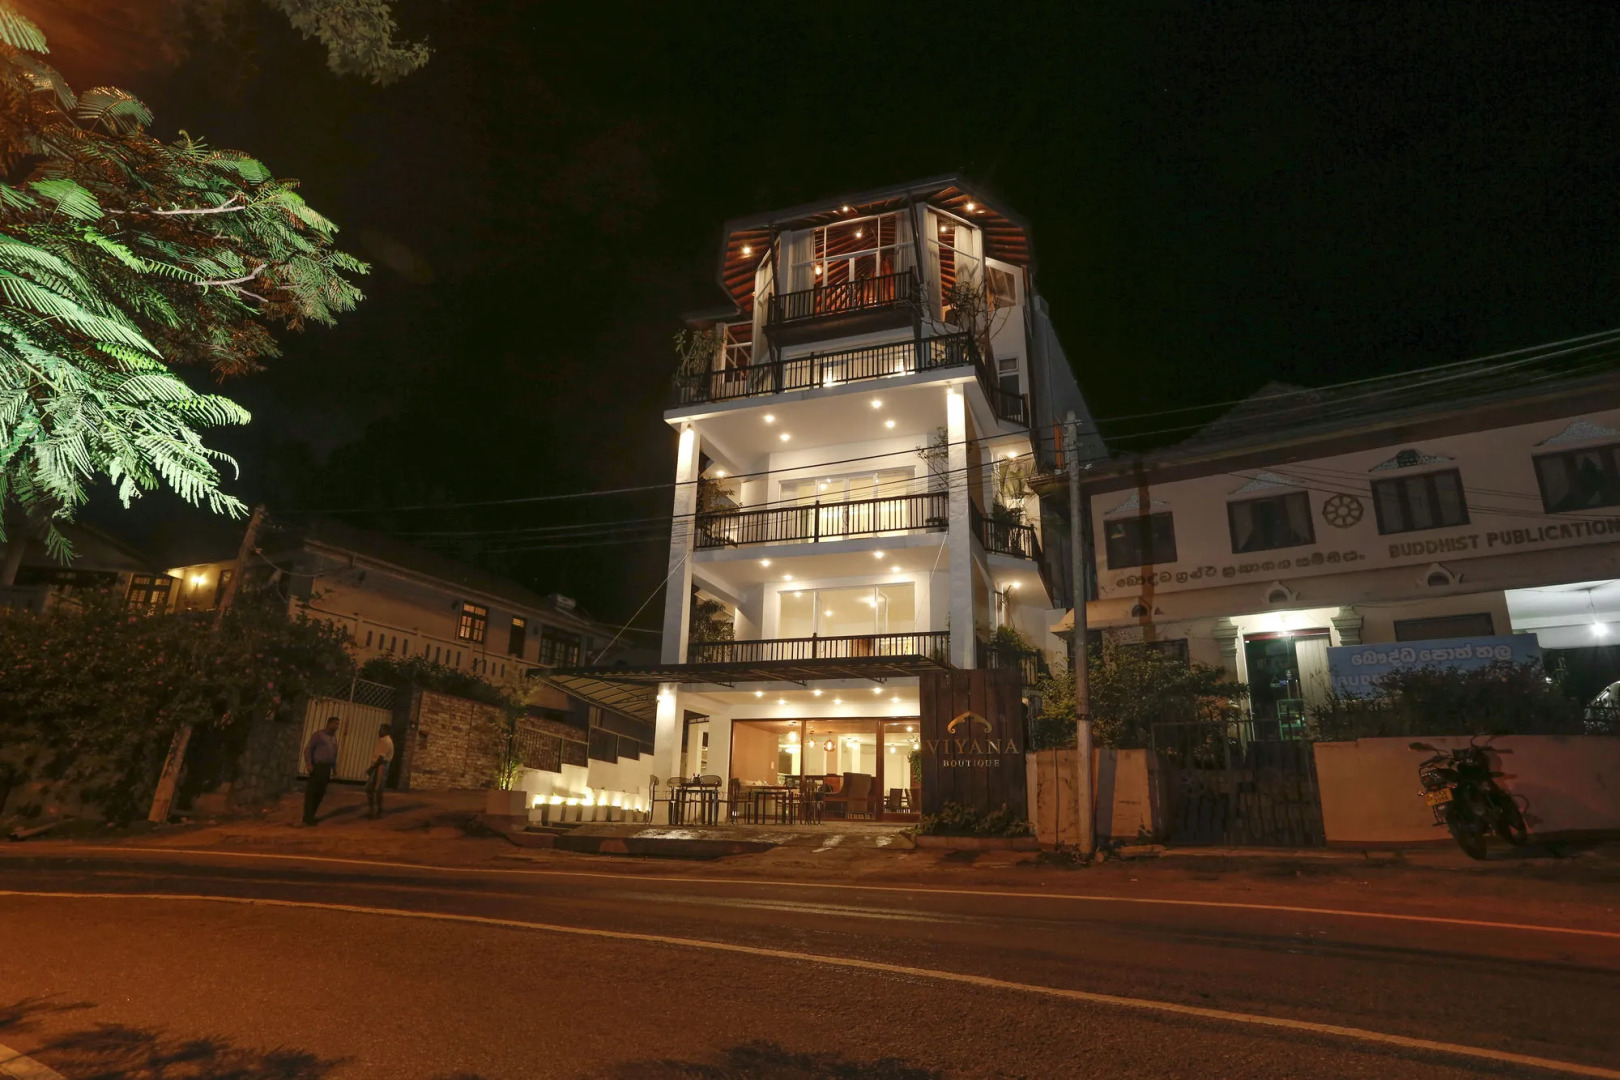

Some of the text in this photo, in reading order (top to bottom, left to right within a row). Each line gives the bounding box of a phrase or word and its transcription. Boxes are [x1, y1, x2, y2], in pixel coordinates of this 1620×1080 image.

[1389, 518, 1620, 559] BUDDHIST PUBLICATION
[926, 738, 1020, 755] VIYANA
[943, 759, 1000, 768] BOUTIQUE
